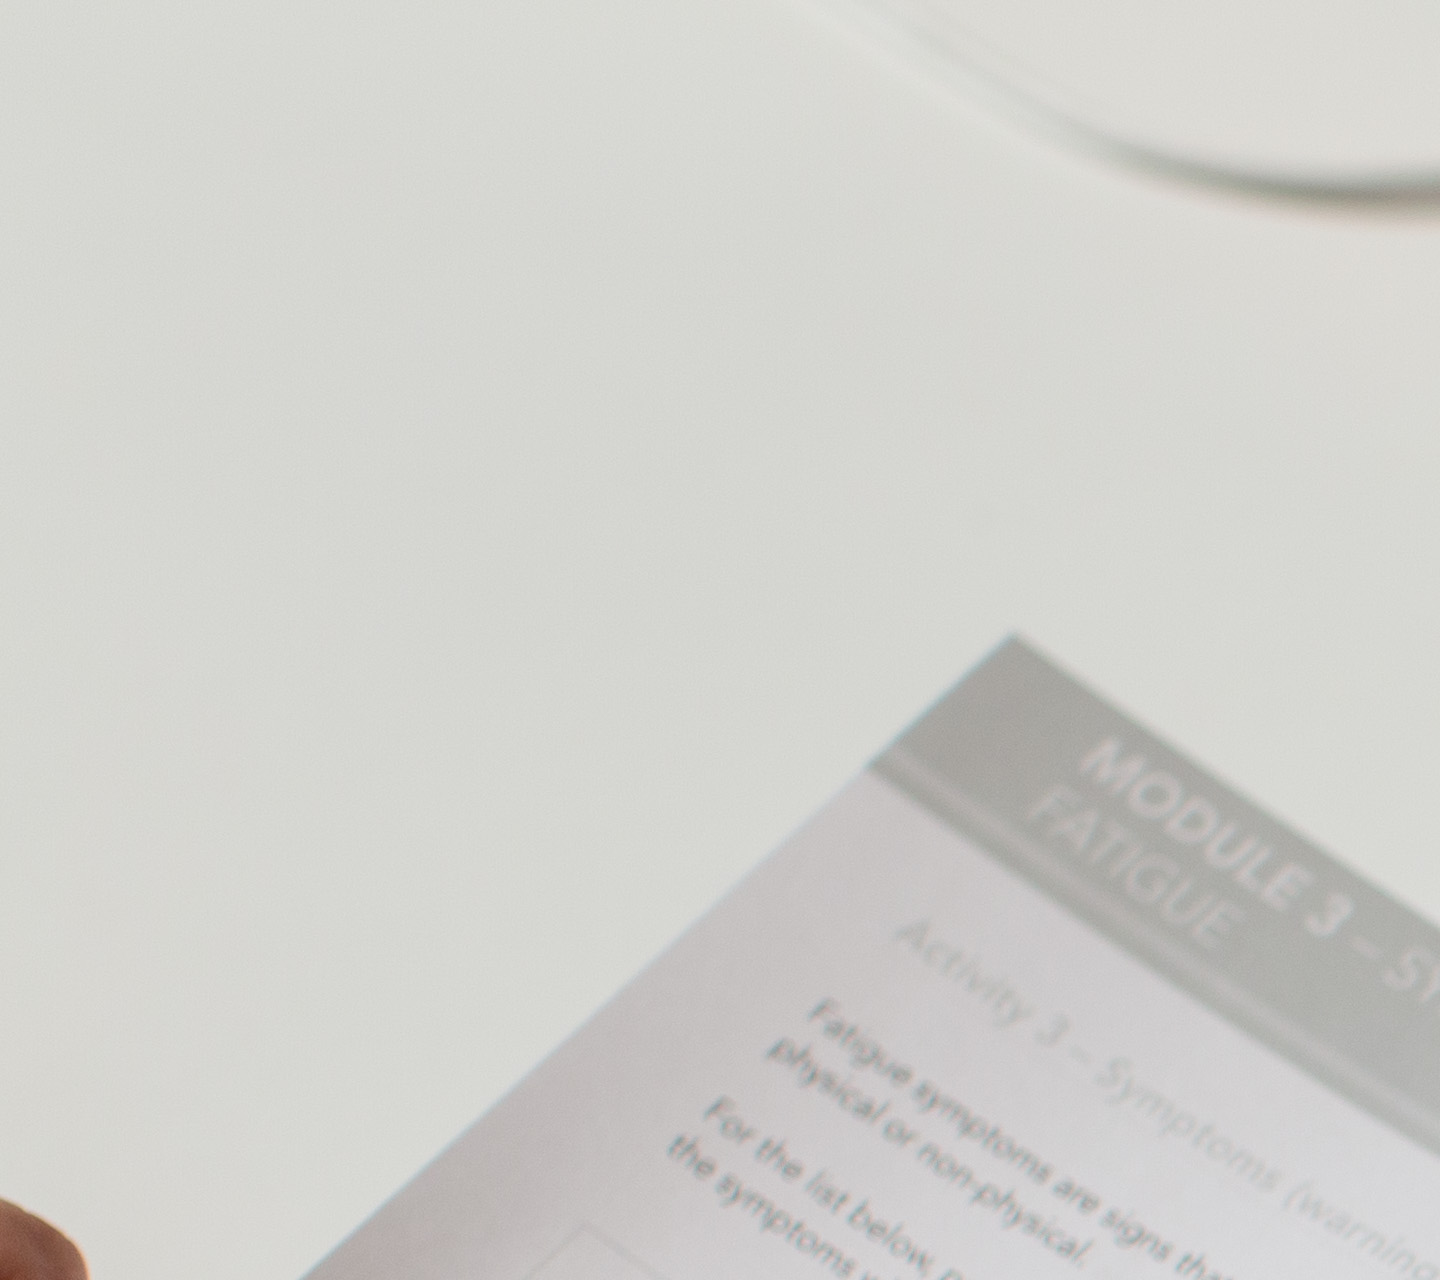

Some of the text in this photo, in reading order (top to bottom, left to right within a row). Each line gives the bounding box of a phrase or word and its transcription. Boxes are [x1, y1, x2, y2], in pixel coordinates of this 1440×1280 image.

[1023, 784, 1246, 952] FATIGUE
[1080, 736, 1309, 912] MODULE
[1305, 893, 1353, 936] 3
[806, 998, 913, 1088] Fatigue
[913, 1080, 1053, 1186] symptoms
[1052, 1180, 1101, 1215] are
[1100, 1208, 1174, 1263] signs
[890, 917, 1033, 1029] Activity
[1034, 1012, 1072, 1048] 3
[1094, 1057, 1283, 1193] Symptoms
